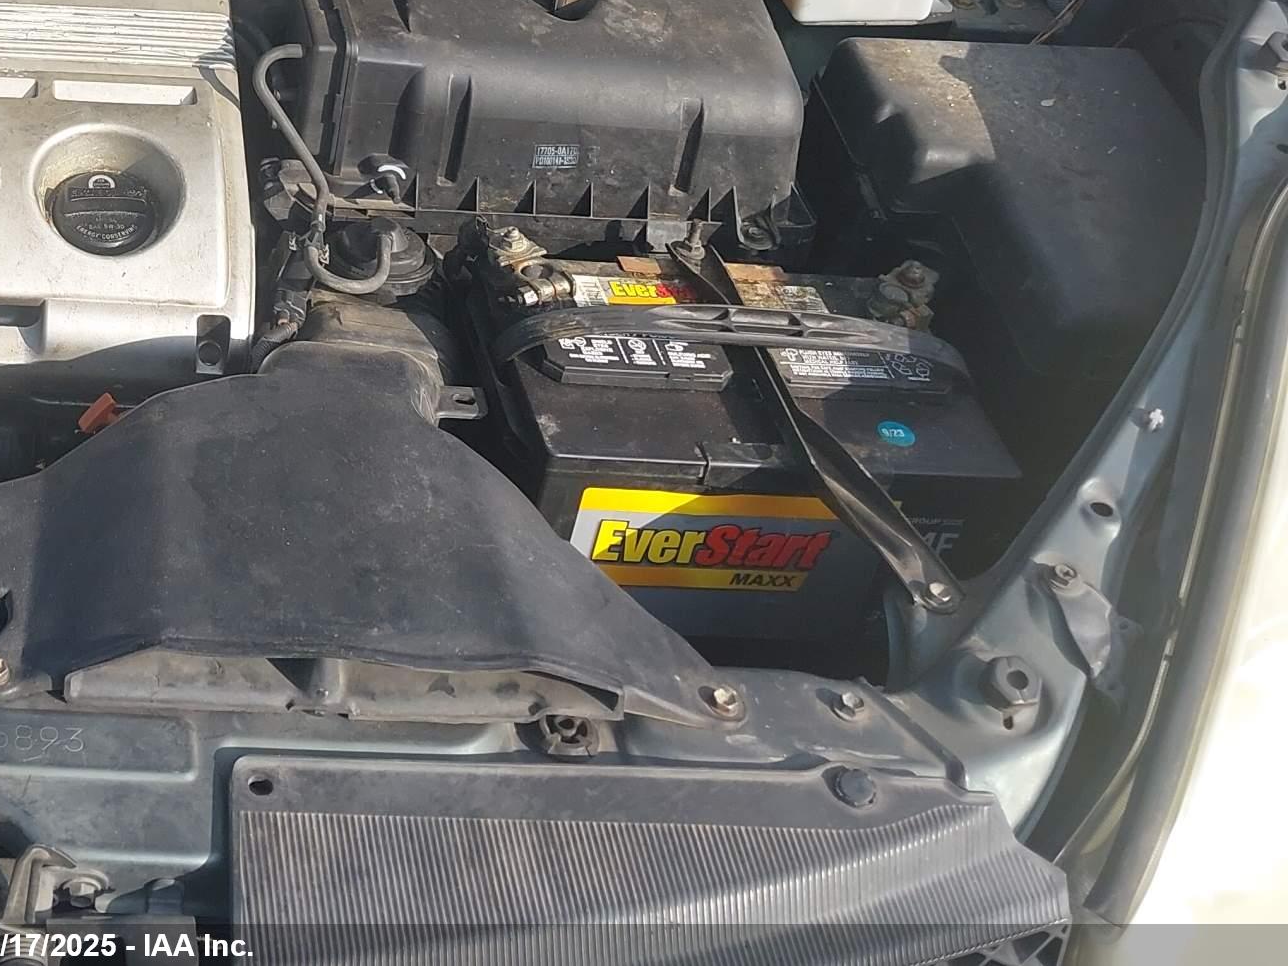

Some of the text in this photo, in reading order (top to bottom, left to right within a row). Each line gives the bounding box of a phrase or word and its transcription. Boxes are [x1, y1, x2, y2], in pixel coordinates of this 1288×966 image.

[880, 427, 906, 438] 9/23
[591, 520, 834, 570] EverStart
[729, 572, 799, 589] MAXX
